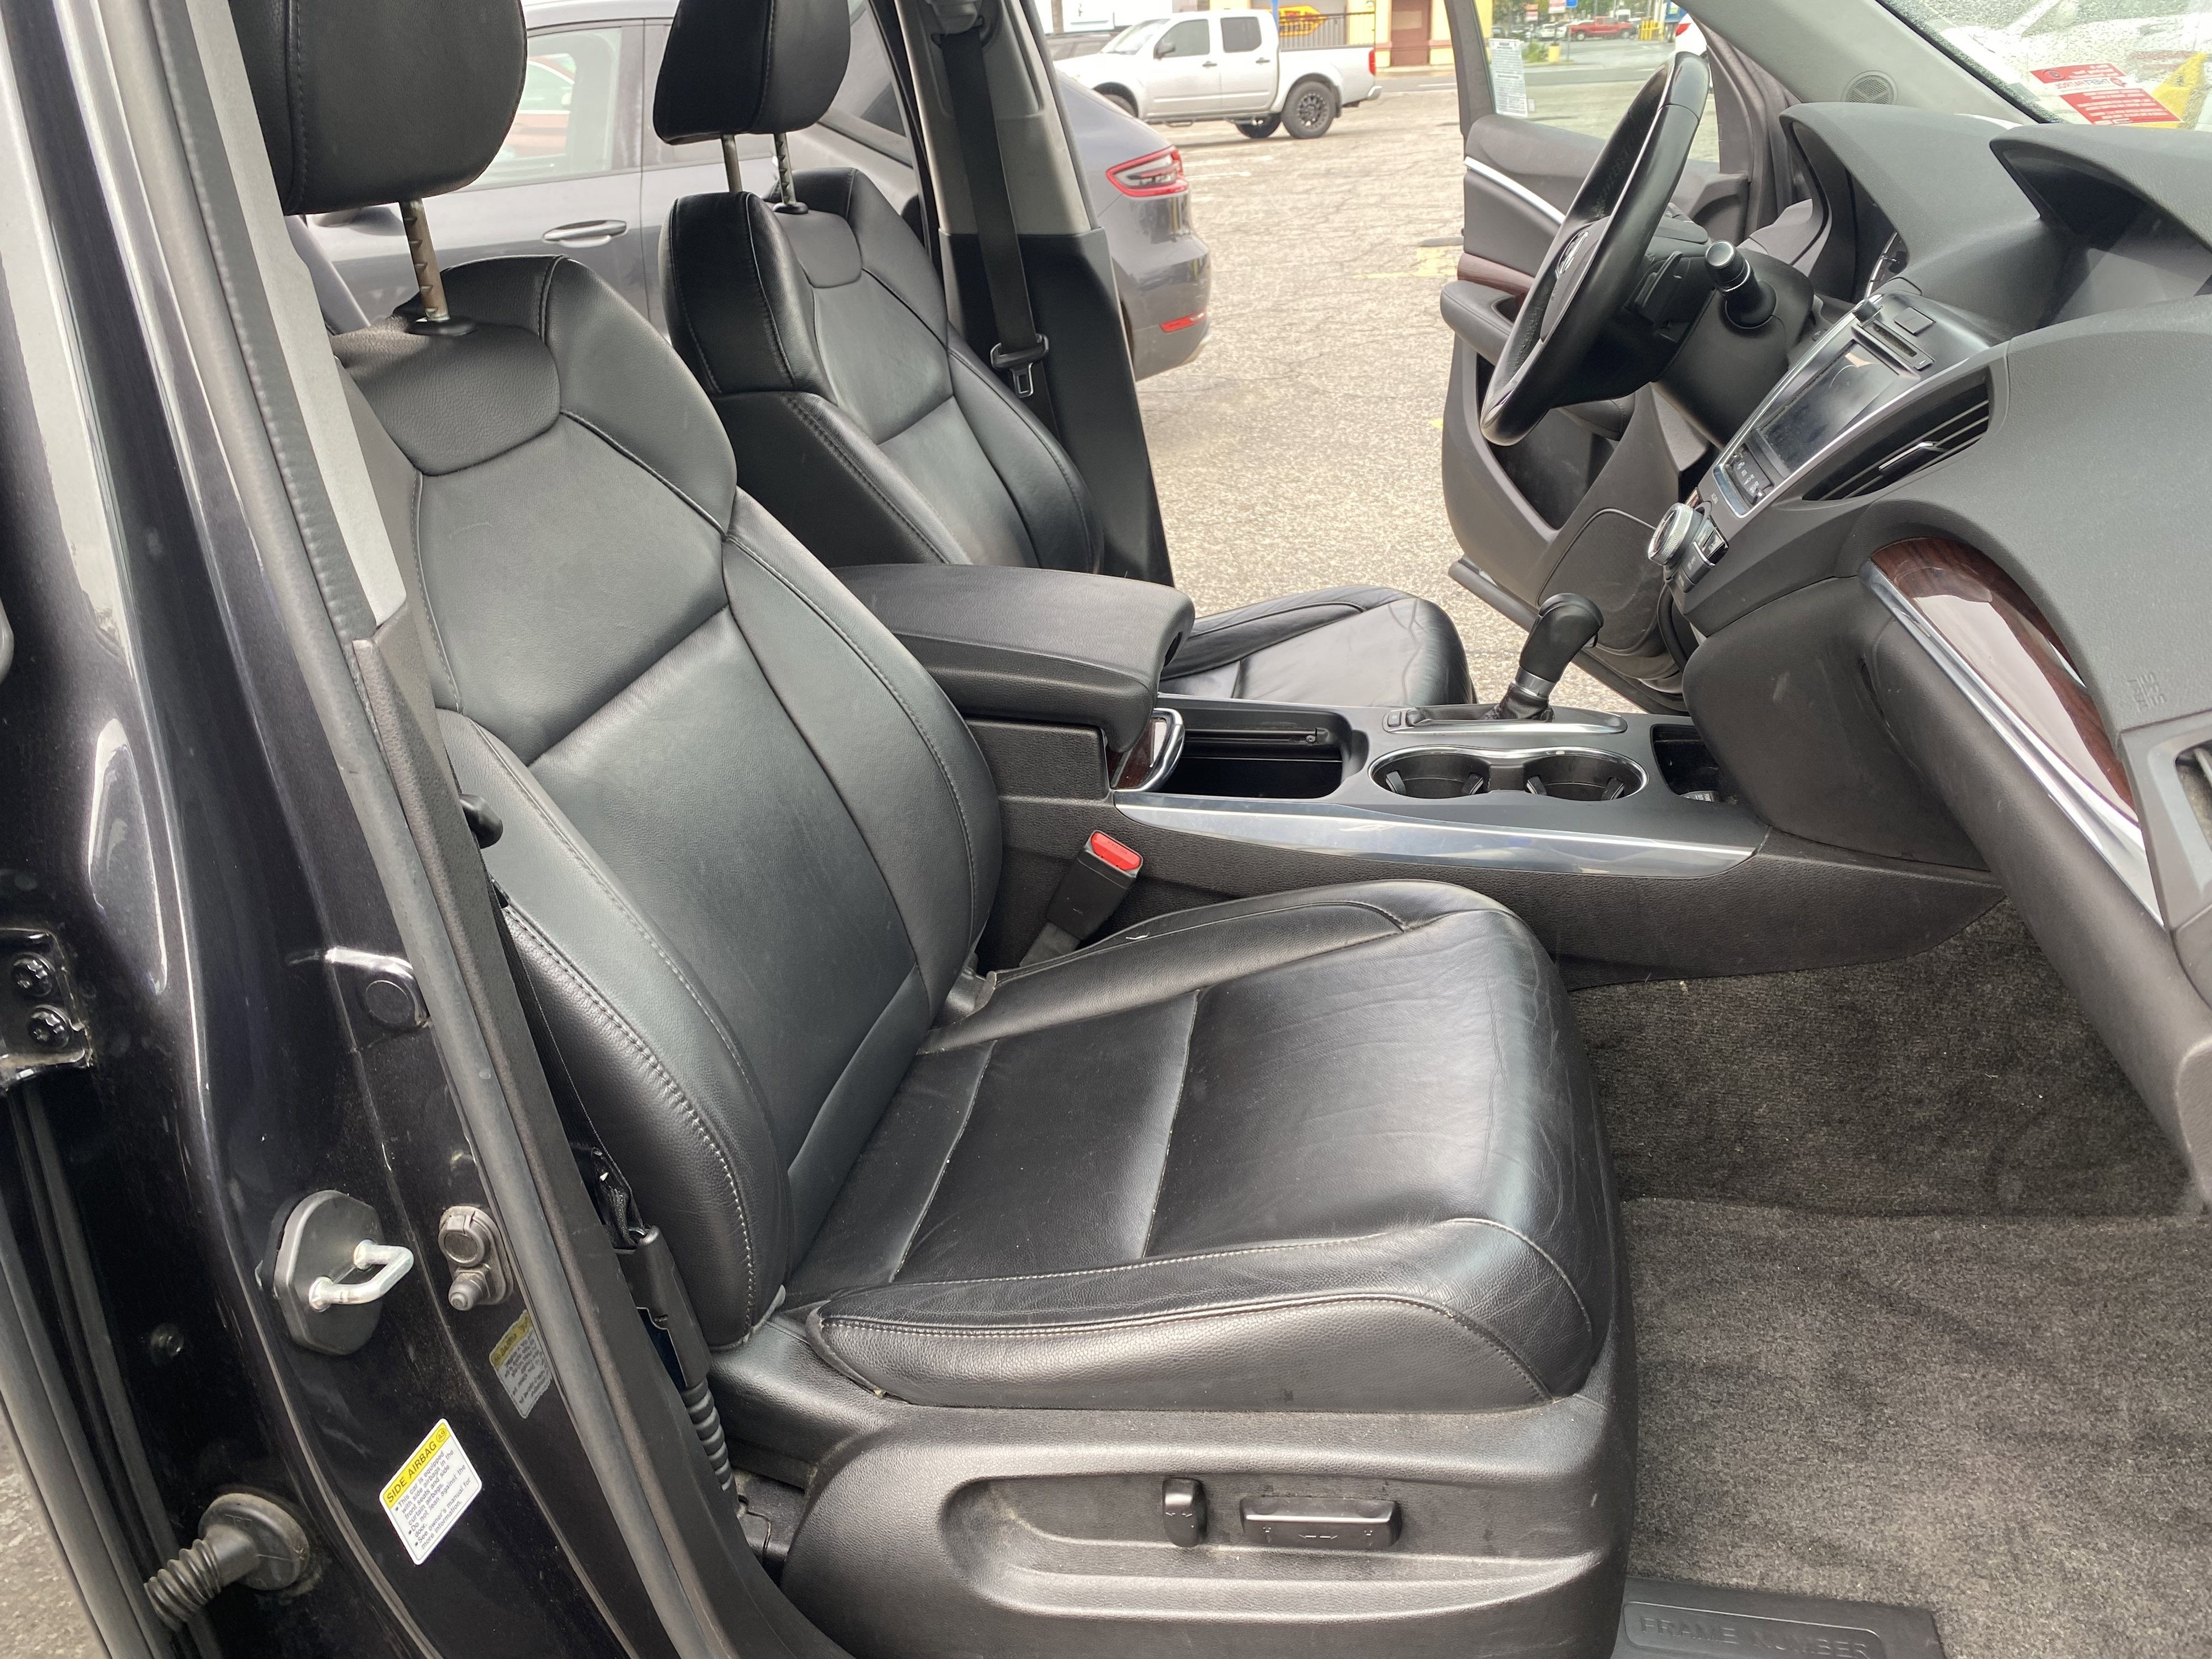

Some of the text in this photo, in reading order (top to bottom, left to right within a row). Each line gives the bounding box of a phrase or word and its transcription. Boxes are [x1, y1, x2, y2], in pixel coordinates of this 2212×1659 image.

[386, 1476, 407, 1503] SIDE
[407, 1441, 437, 1479] AIRBAG
[398, 1494, 409, 1506] This
[410, 1483, 418, 1494] car
[424, 1451, 444, 1477] equipped
[402, 1500, 412, 1514] with
[413, 1488, 423, 1501] side
[423, 1466, 440, 1488] airbags
[445, 1450, 454, 1460] the
[404, 1464, 450, 1520] front seats and side
[411, 1465, 466, 1532] Do not lean against the
[409, 1504, 425, 1525] curtain
[417, 1531, 428, 1543] See
[428, 1508, 447, 1531] owner's
[447, 1486, 464, 1508] manual
[421, 1533, 435, 1550] more
[1640, 1617, 1737, 1644] FRAME
